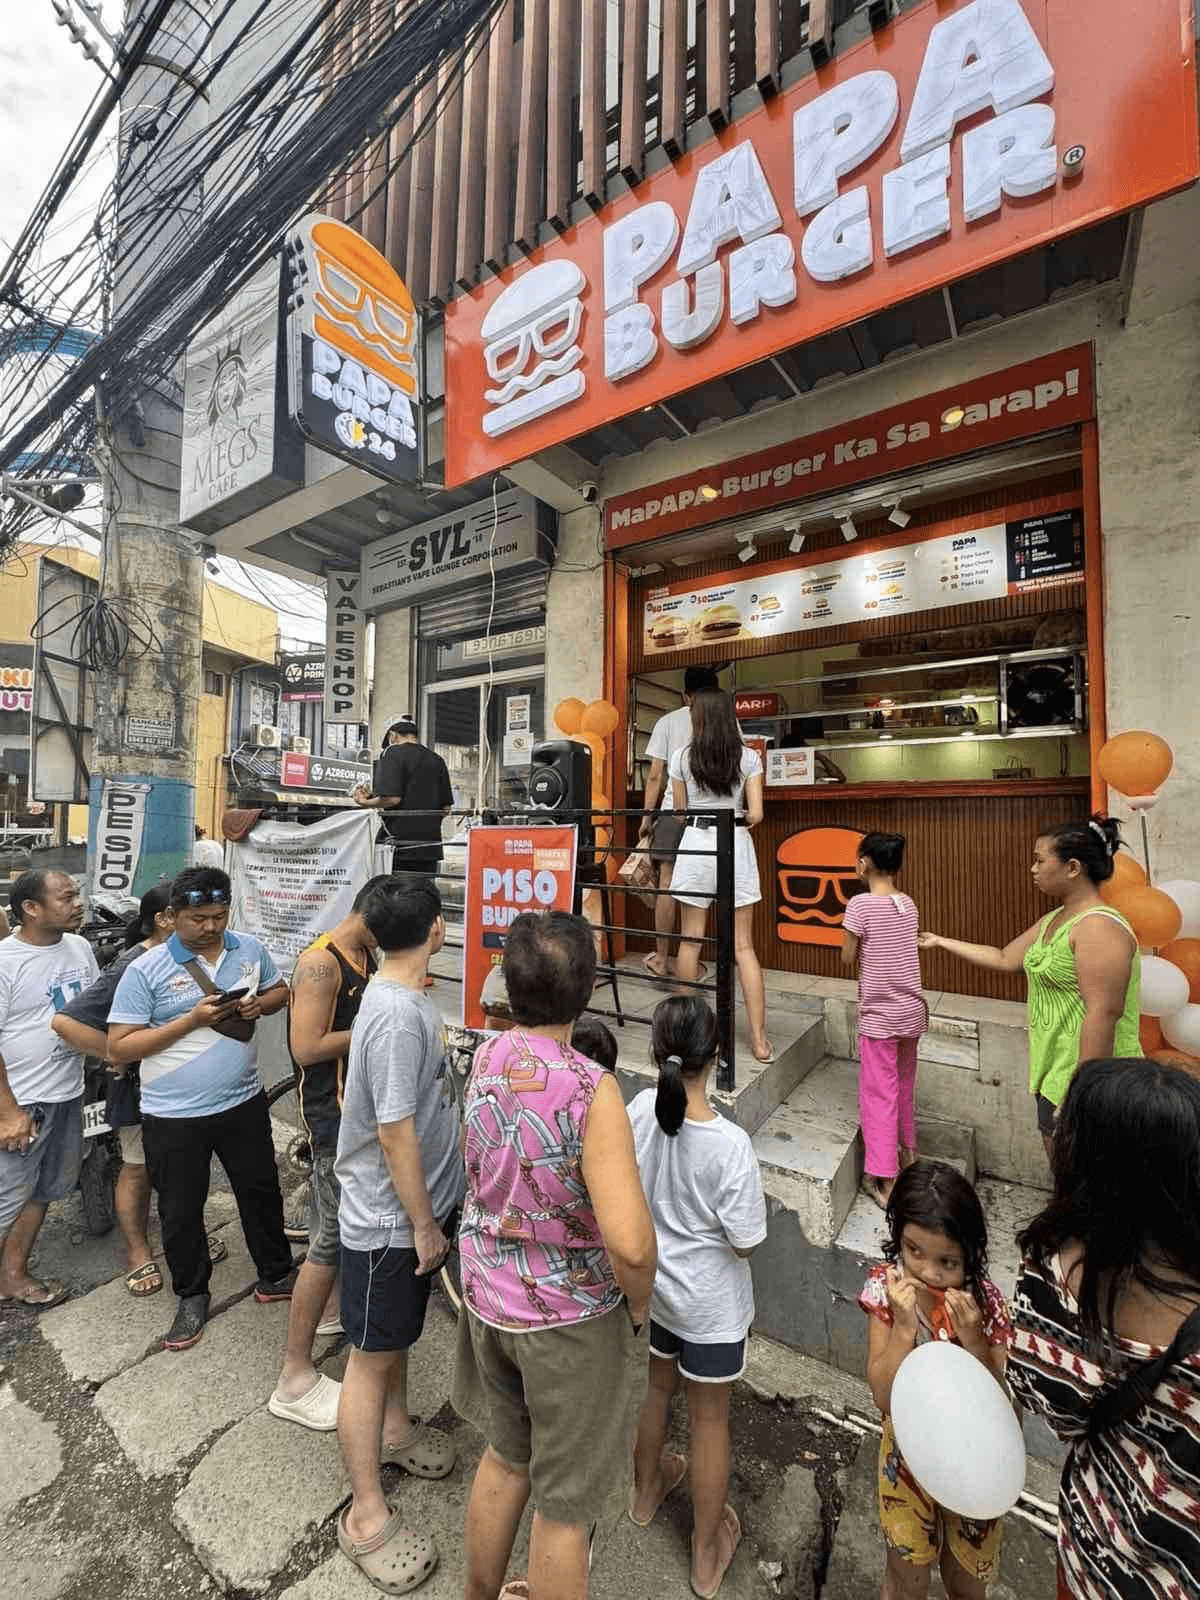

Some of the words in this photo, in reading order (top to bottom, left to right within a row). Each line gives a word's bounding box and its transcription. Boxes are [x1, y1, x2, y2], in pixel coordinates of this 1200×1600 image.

[603, 0, 1055, 315] PAPA
[603, 102, 1056, 384] BURGER
[311, 372, 417, 449] BURGER
[312, 339, 416, 427] PAPA
[833, 438, 878, 466] Ka
[886, 421, 931, 450] Sa
[408, 520, 471, 572] SVL
[332, 578, 358, 714] VAPESHOP
[736, 699, 772, 711] ARP
